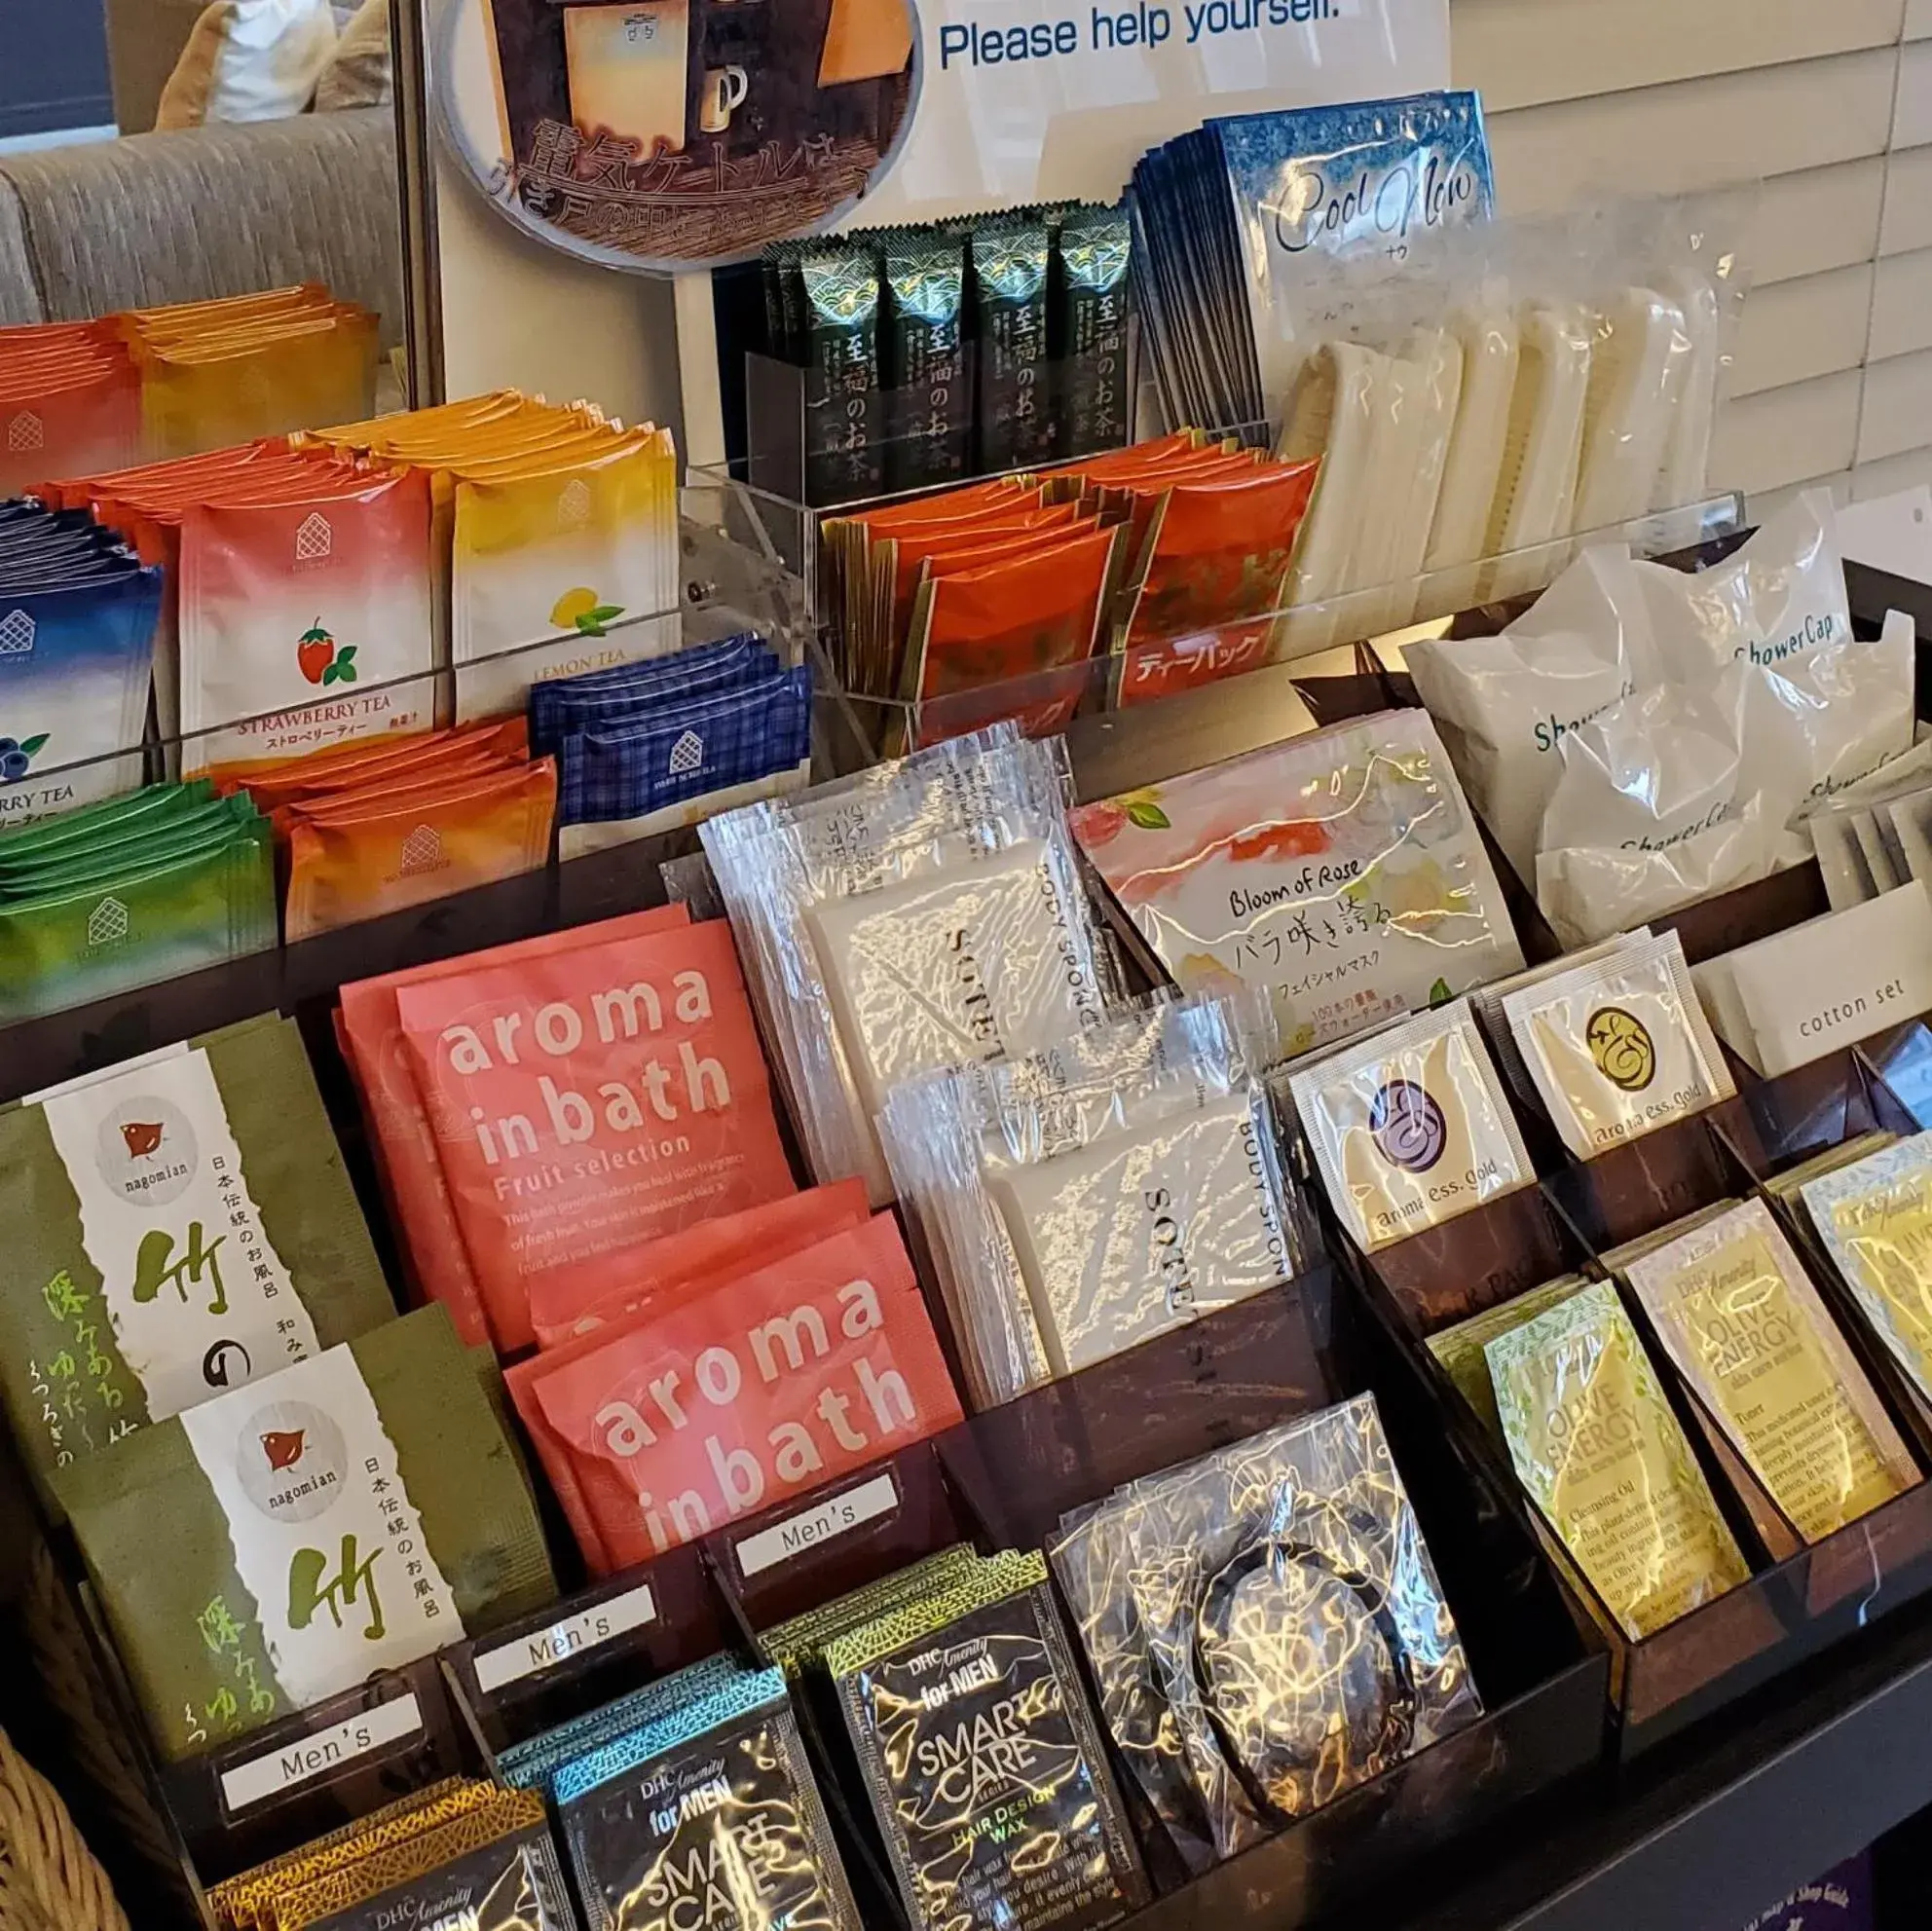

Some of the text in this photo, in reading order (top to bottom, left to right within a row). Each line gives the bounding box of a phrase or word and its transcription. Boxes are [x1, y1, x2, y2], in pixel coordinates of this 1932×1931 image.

[940, 0, 1341, 70] Please help yourself.
[531, 116, 839, 197] 電気ケトルは
[1276, 156, 1471, 252] Cool Now
[533, 649, 627, 680] LEMON TEA
[238, 695, 392, 736] STRAWBERRY TEA
[40, 784, 74, 805] TEA
[1036, 863, 1068, 928] BODY
[1229, 884, 1290, 917] Bloom
[1318, 859, 1363, 888] Rose
[1234, 894, 1393, 970] バラ咲き誇る
[1278, 949, 1381, 1001] フェイシャルマスク
[438, 969, 715, 1075] aroma
[1799, 979, 1906, 1038] cotton set
[469, 1041, 731, 1166] in bath
[124, 1161, 190, 1194] nagomian
[493, 1135, 691, 1202] Fruit selection
[210, 1156, 279, 1300] 日本伝統のお風呂
[1145, 1187, 1200, 1316] SOTE
[132, 1220, 229, 1316] 竹
[1706, 1301, 1775, 1346] OLIVE
[1713, 1311, 1799, 1379] ENERGY
[202, 1338, 252, 1389] の
[594, 1278, 885, 1458] aroma
[1545, 1403, 1641, 1463] ENERGY
[1546, 1383, 1620, 1438] OLIVE
[1733, 1403, 1765, 1425] Toner
[636, 1355, 917, 1551] in bath
[268, 1469, 340, 1509] nagomian
[1568, 1489, 1617, 1524] Cleansing
[1616, 1479, 1636, 1496] Oil
[363, 1456, 442, 1619] 日本伝統のお風呂
[779, 1503, 856, 1552] Men's
[285, 1533, 386, 1641] 竹
[526, 1615, 612, 1666] Men's
[908, 1647, 943, 1677] DHC
[920, 1652, 1000, 1713] for MEN
[279, 1725, 373, 1782] Men's
[916, 1688, 1033, 1777] SMART
[640, 1771, 679, 1801] DHC
[938, 1730, 1038, 1804] CARE
[649, 1773, 732, 1838] for MEN
[950, 1784, 1058, 1849] HAIR DESIGN
[988, 1817, 1029, 1845] WAX
[645, 1811, 771, 1909] SMART
[375, 1897, 416, 1931] DHC
[668, 1856, 777, 1931] CAE
